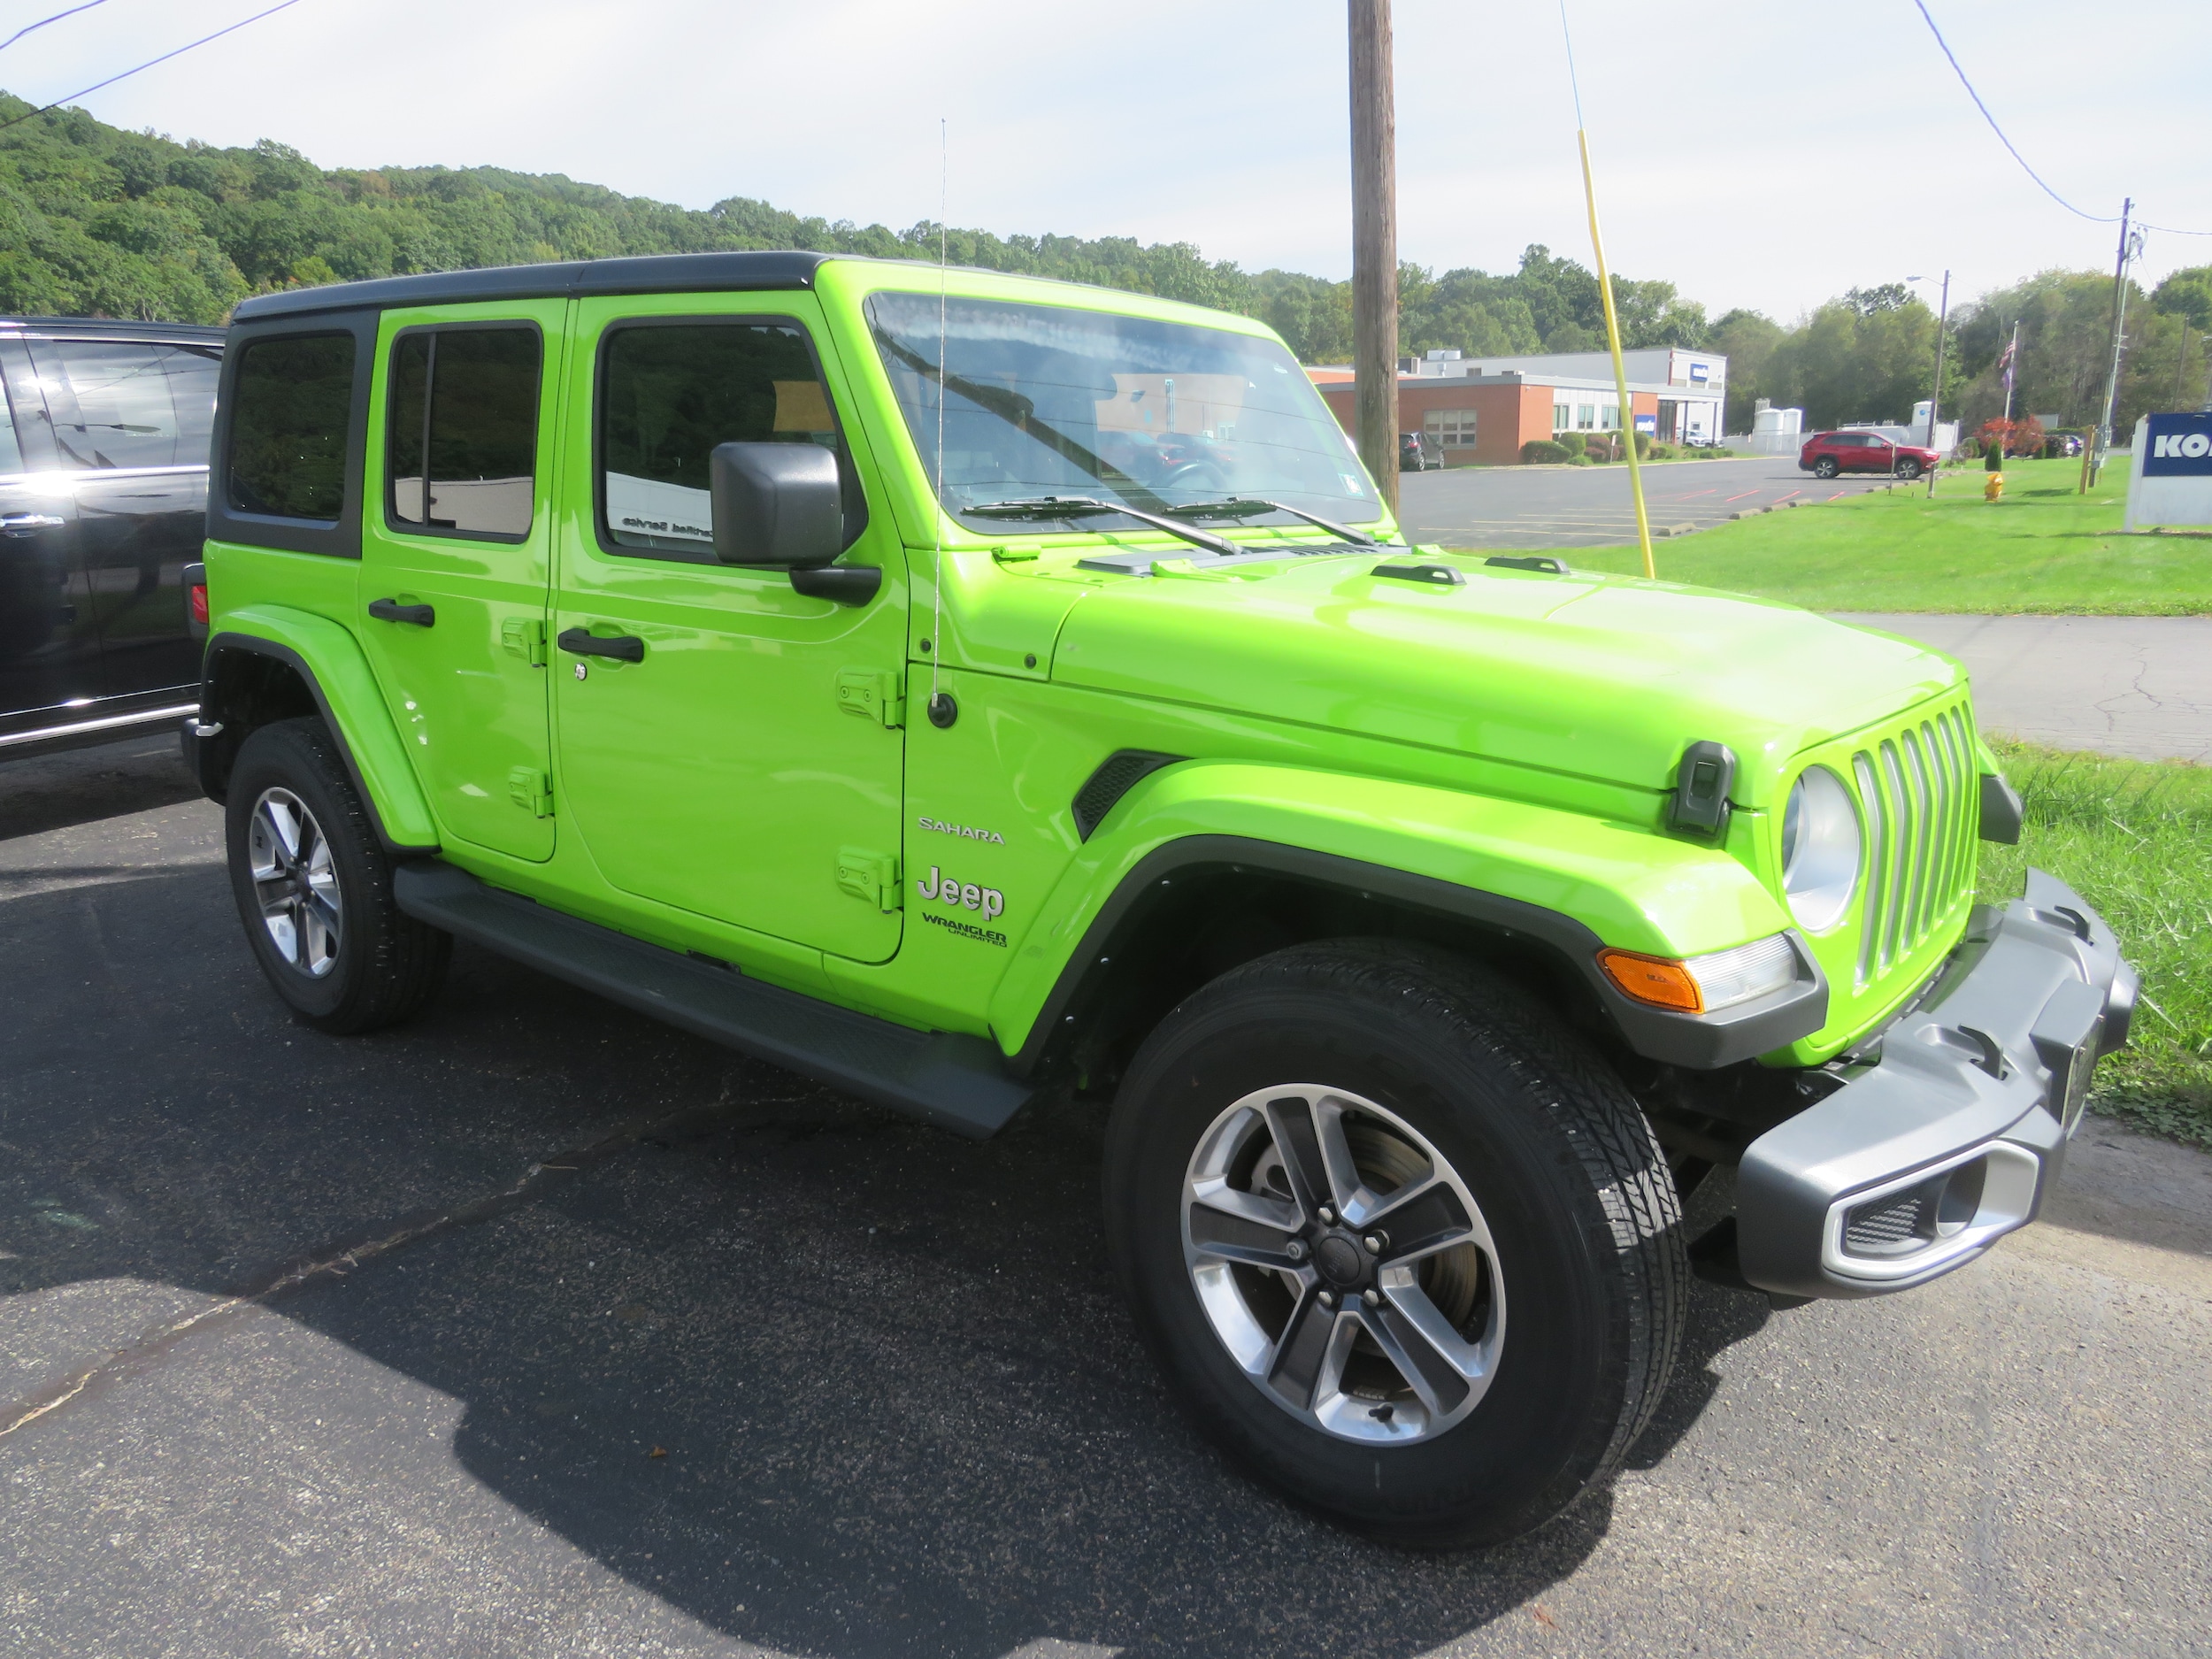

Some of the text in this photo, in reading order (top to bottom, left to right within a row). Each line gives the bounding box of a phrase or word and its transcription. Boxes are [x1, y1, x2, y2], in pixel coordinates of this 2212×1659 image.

[2153, 433, 2212, 458] KO
[918, 816, 1005, 846] SAHARA
[917, 865, 1005, 922] Jeep
[921, 911, 1007, 943] WRANGLER
[947, 928, 1008, 948] UNLIMITED
